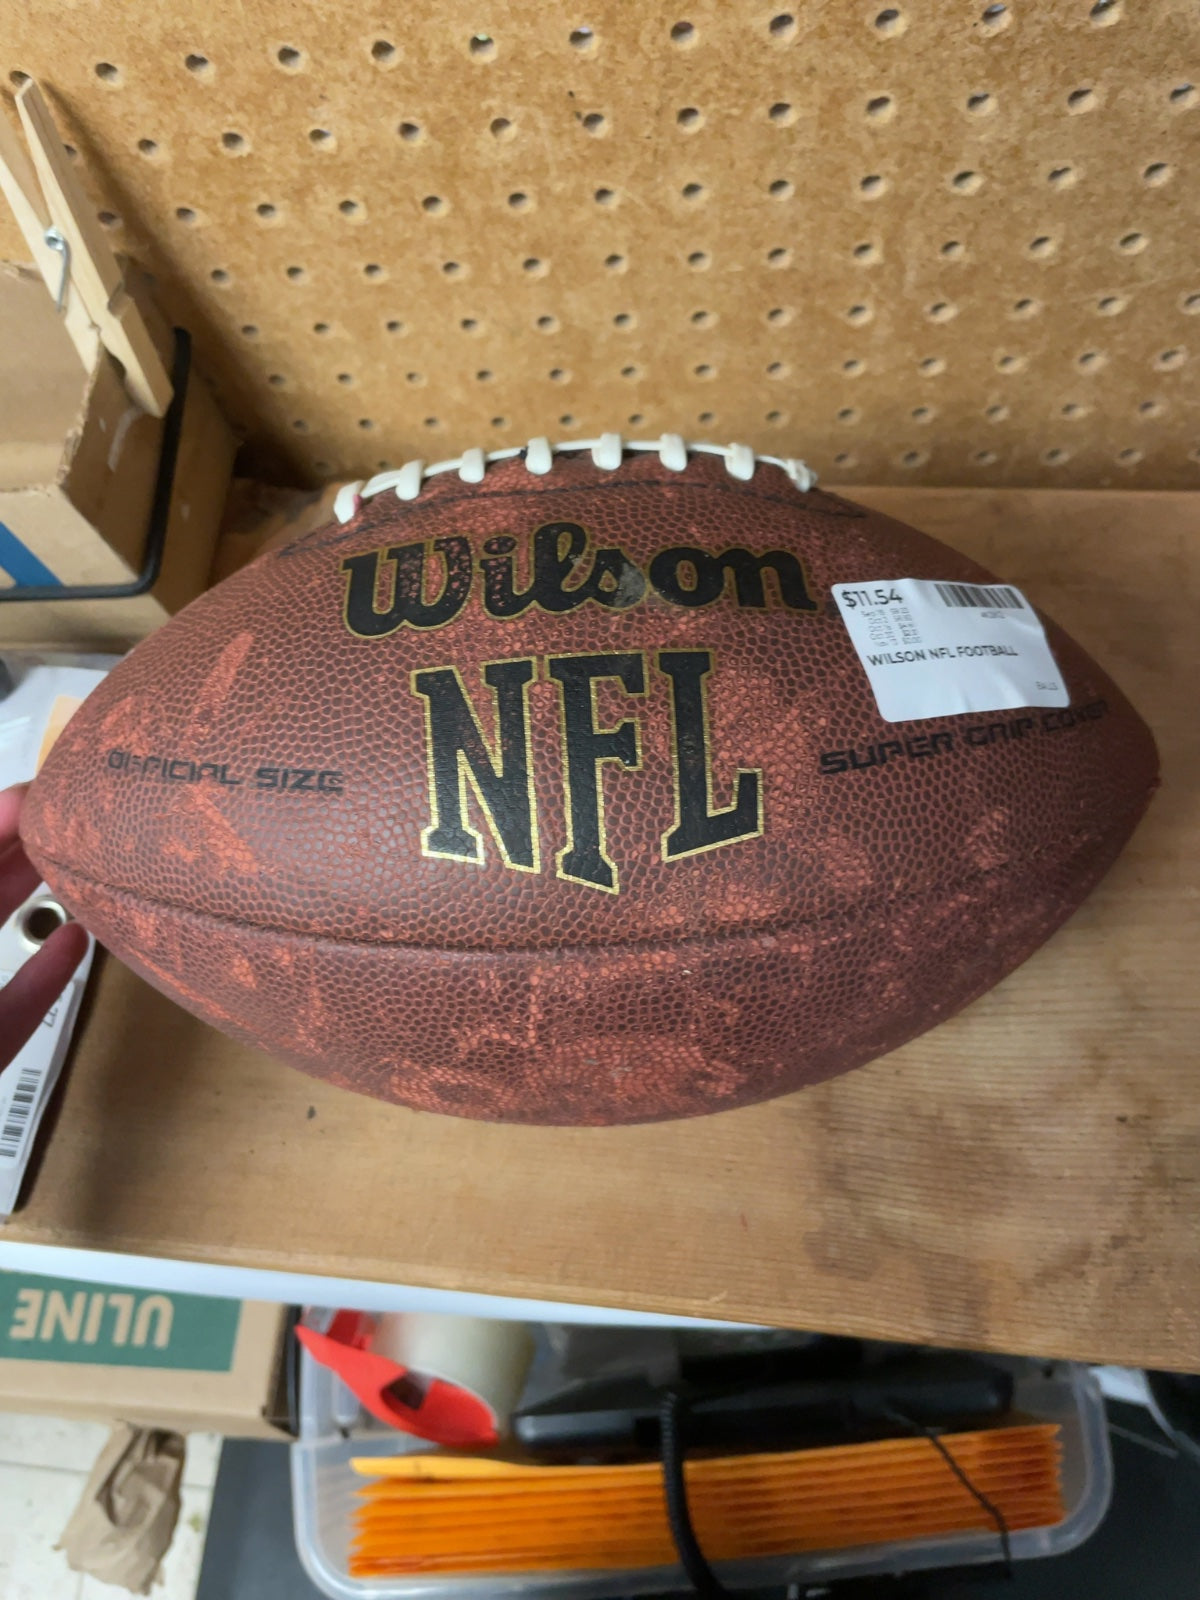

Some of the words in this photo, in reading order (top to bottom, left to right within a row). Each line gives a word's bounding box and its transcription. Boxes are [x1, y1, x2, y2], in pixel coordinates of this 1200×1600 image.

[340, 521, 819, 640] Wilson
[841, 587, 903, 610] $11.54
[866, 649, 926, 666] WILSON
[929, 646, 956, 660] NFL
[956, 645, 1018, 658] FOOTBALL
[410, 647, 764, 896] NFL
[820, 731, 954, 776] SUPER
[964, 717, 1033, 747] GRIP
[256, 766, 344, 792] SIZE
[8, 1288, 174, 1350] ULINE
